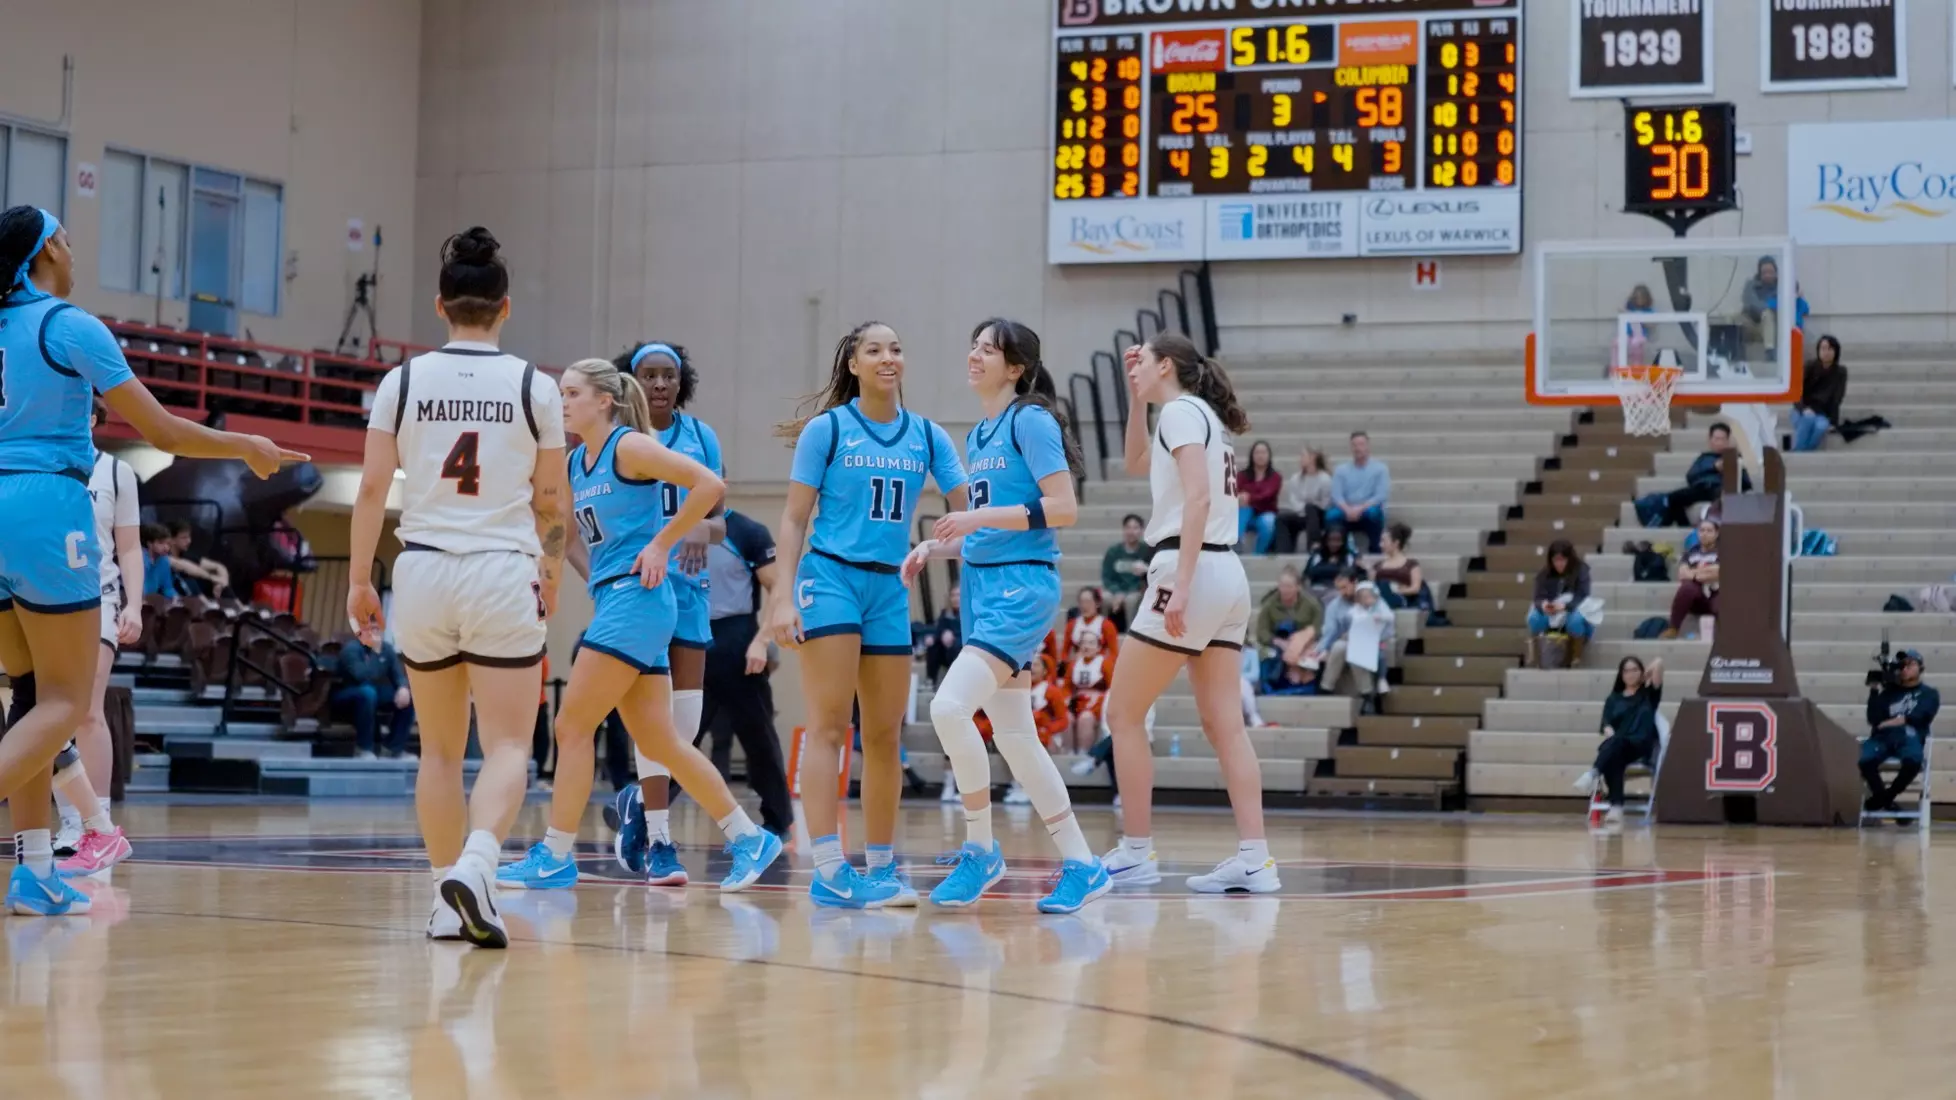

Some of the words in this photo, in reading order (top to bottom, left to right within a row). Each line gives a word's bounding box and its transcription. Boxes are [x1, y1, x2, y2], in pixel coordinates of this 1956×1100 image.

[1441, 42, 1458, 68] 0
[1464, 41, 1479, 67] 3
[1505, 42, 1514, 64] 1
[1602, 29, 1682, 67] 1939
[1792, 22, 1874, 60] 1986
[1070, 61, 1088, 81] 4
[1090, 57, 1107, 82] 2
[1117, 56, 1140, 81] 10
[1334, 64, 1409, 87] COLUMBIA
[1069, 87, 1087, 112] 5
[1091, 86, 1107, 111] 3
[1123, 84, 1140, 110] 0
[1448, 74, 1458, 96] 1
[1462, 71, 1479, 97] 2
[1498, 72, 1514, 93] 4
[1172, 93, 1218, 133] 25
[1272, 94, 1292, 127] 3
[1355, 86, 1403, 127] 58
[1433, 102, 1458, 128] 10
[1469, 103, 1479, 125] 1
[1500, 100, 1514, 124] 7
[1062, 118, 1087, 139] 11
[1090, 115, 1106, 139] 2
[1123, 114, 1140, 138] 0
[1055, 144, 1086, 170] 22
[1089, 143, 1105, 169] 0
[1122, 142, 1139, 167] 0
[1383, 140, 1402, 173] 3
[1433, 134, 1457, 156] 11
[1462, 131, 1478, 156] 0
[1497, 129, 1514, 156] 0
[1169, 150, 1189, 177] 4
[1210, 146, 1229, 178] 3
[1247, 144, 1268, 177] 2
[1293, 143, 1313, 173] 4
[1332, 143, 1353, 172] 4
[1651, 143, 1708, 199] 30
[1055, 173, 1086, 199] 25
[1090, 172, 1105, 197] 3
[1122, 171, 1138, 196] 2
[1433, 160, 1457, 187] 12
[1461, 160, 1478, 186] 0
[1257, 201, 1343, 220] UNIVERSITY
[1398, 200, 1480, 215] LEXUS
[1070, 214, 1185, 247] BayCoast
[1257, 221, 1342, 240] ORTHOPEDICS
[1367, 229, 1412, 244] LEXUS
[1415, 229, 1436, 242] OF
[1440, 227, 1511, 242] WARWICK
[1417, 262, 1436, 284] H
[417, 399, 514, 424] MAURICIO
[441, 431, 480, 496] 4
[843, 454, 924, 475] COLUMBIA
[869, 475, 906, 523] 11
[65, 531, 88, 569] C
[798, 579, 816, 609] C
[1705, 701, 1778, 791] B
